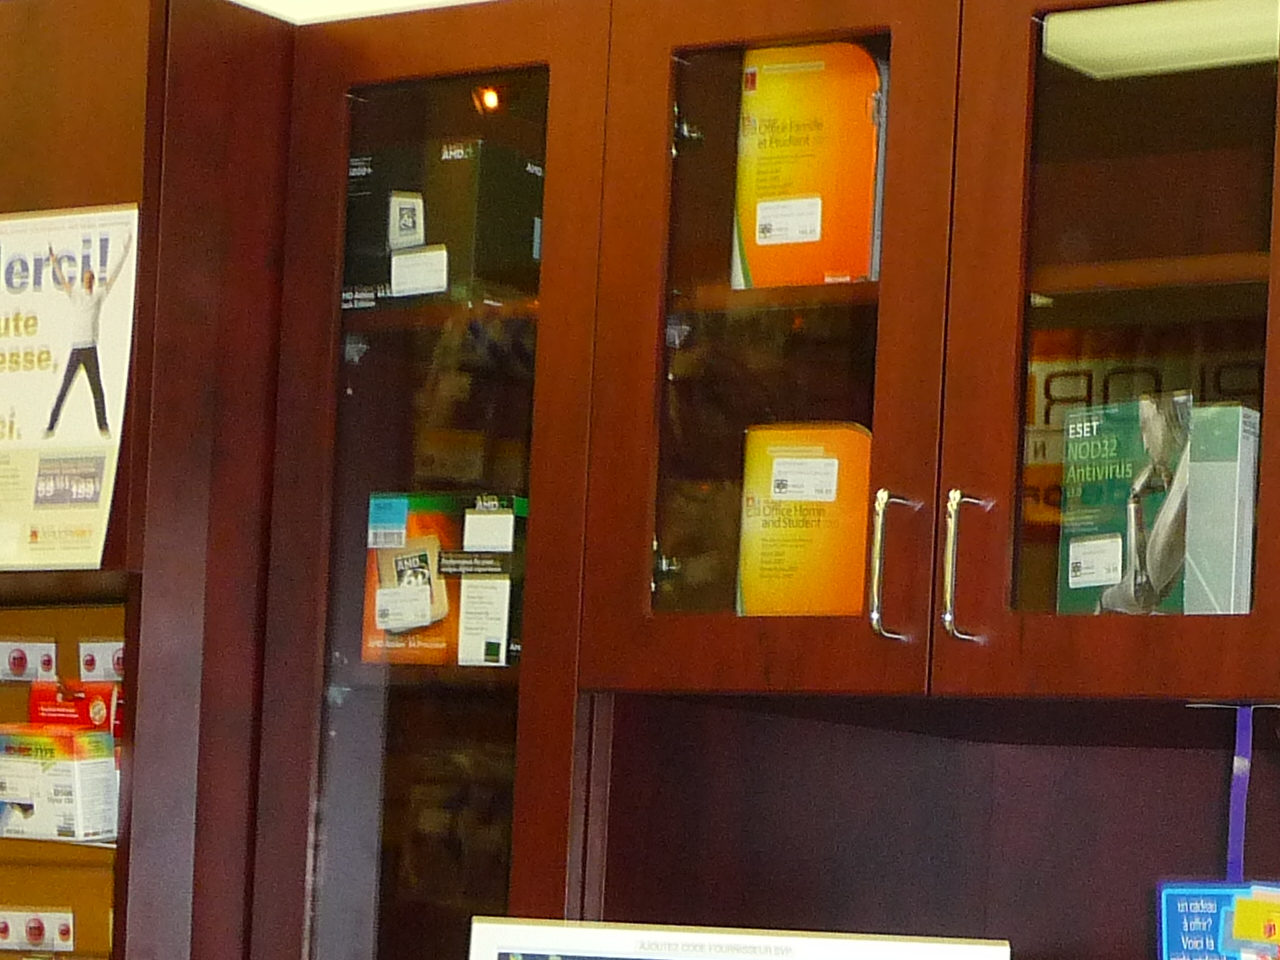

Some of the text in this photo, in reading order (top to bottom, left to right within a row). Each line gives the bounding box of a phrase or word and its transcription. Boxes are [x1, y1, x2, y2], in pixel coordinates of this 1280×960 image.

[0, 231, 110, 294] erci!
[1069, 422, 1098, 439] ESET
[1067, 440, 1118, 462] NOD32
[1066, 462, 1133, 485] Antivirus
[762, 504, 792, 517] Office
[761, 516, 821, 530] and Student
[1189, 899, 1217, 914] cadeau
[1181, 933, 1204, 950] Voici
